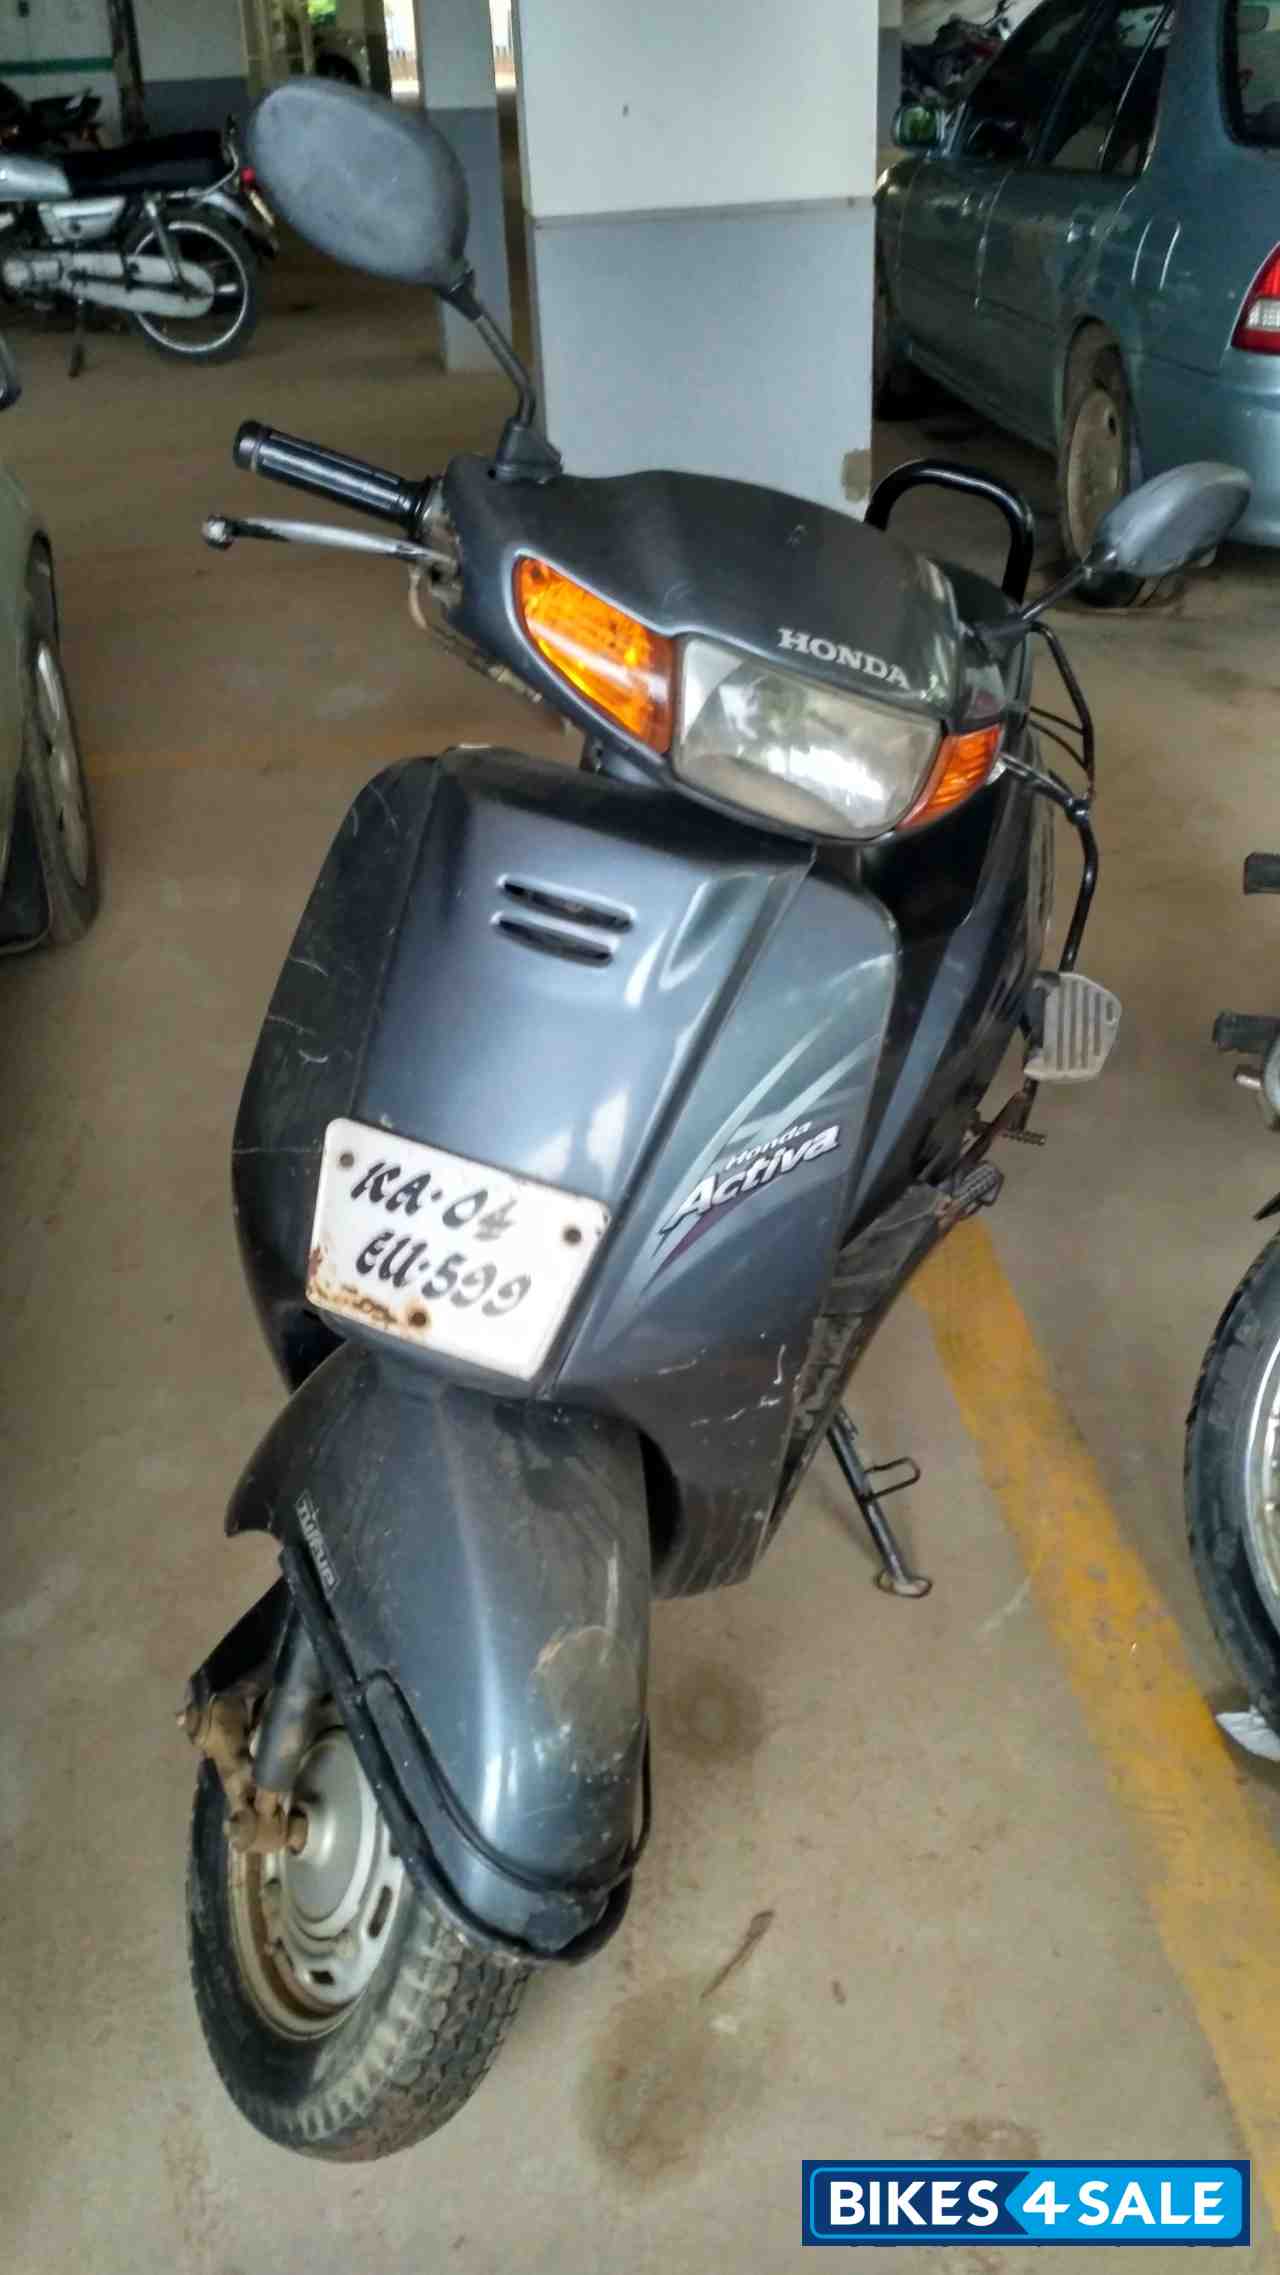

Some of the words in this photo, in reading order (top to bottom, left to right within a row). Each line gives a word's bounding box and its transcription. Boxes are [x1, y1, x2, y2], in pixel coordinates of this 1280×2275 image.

[777, 627, 911, 690] HONDA
[725, 1121, 812, 1170] Honda
[658, 1125, 840, 1235] Activa
